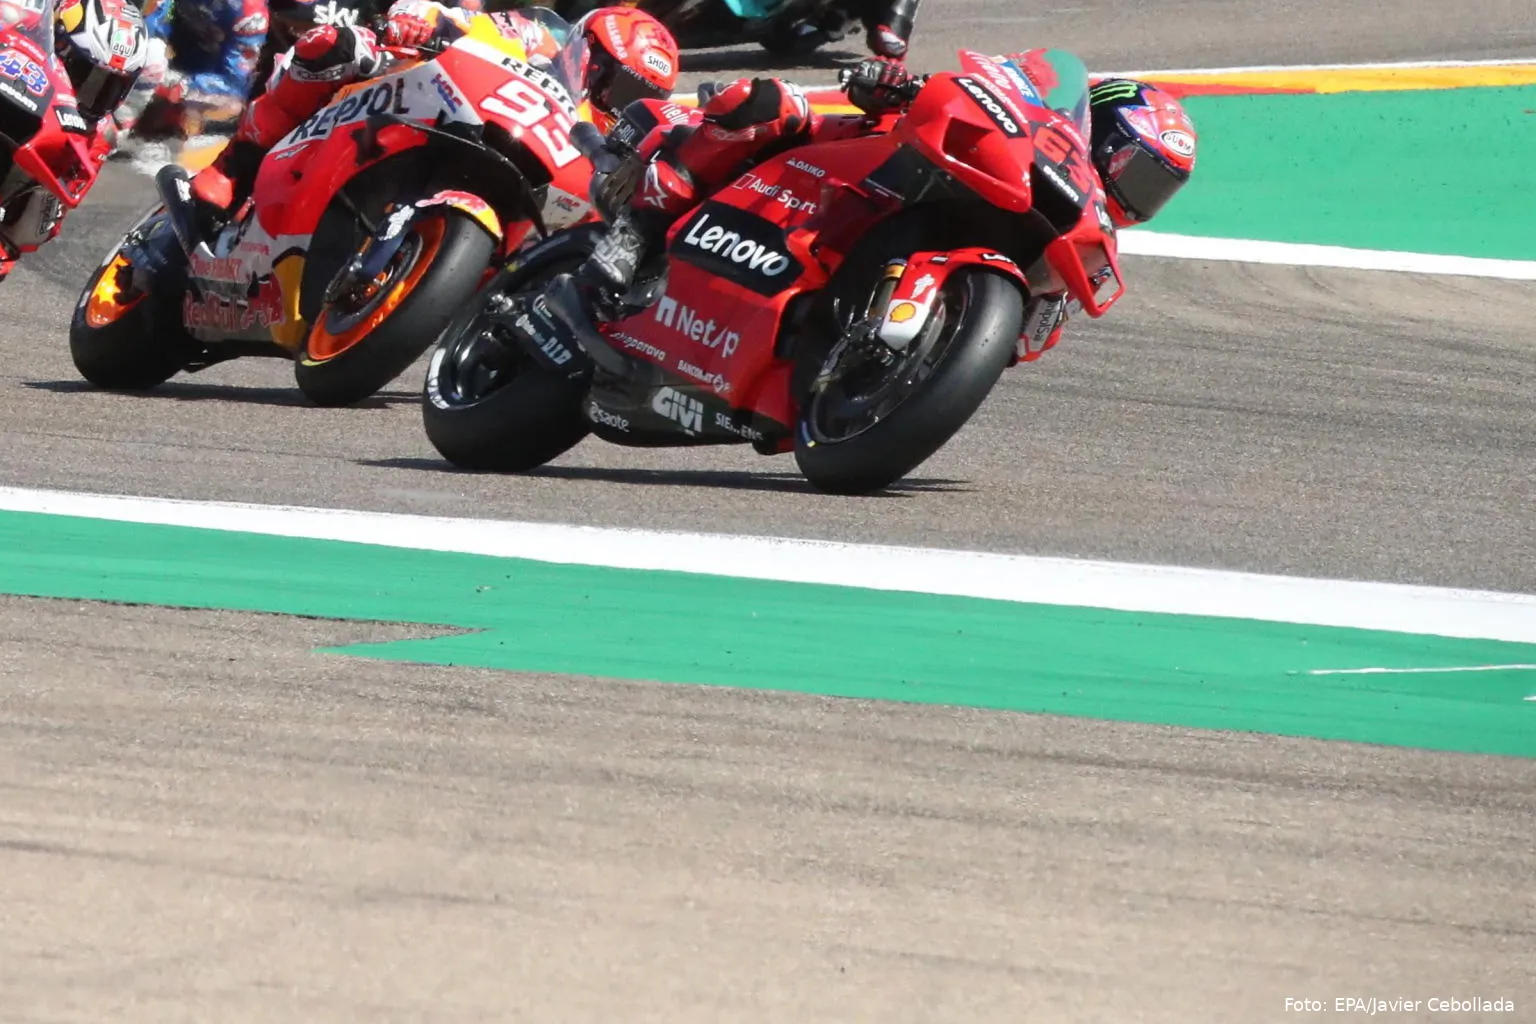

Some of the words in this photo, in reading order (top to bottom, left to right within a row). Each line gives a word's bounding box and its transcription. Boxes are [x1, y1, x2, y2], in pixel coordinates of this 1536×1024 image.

[289, 78, 409, 144] REPSOL
[479, 79, 582, 168] 93
[957, 78, 1018, 135] Lenovo
[1162, 132, 1193, 154] SUOM
[748, 181, 778, 197] Audi
[684, 213, 790, 276] Lenovo
[652, 387, 704, 433] GIVI
